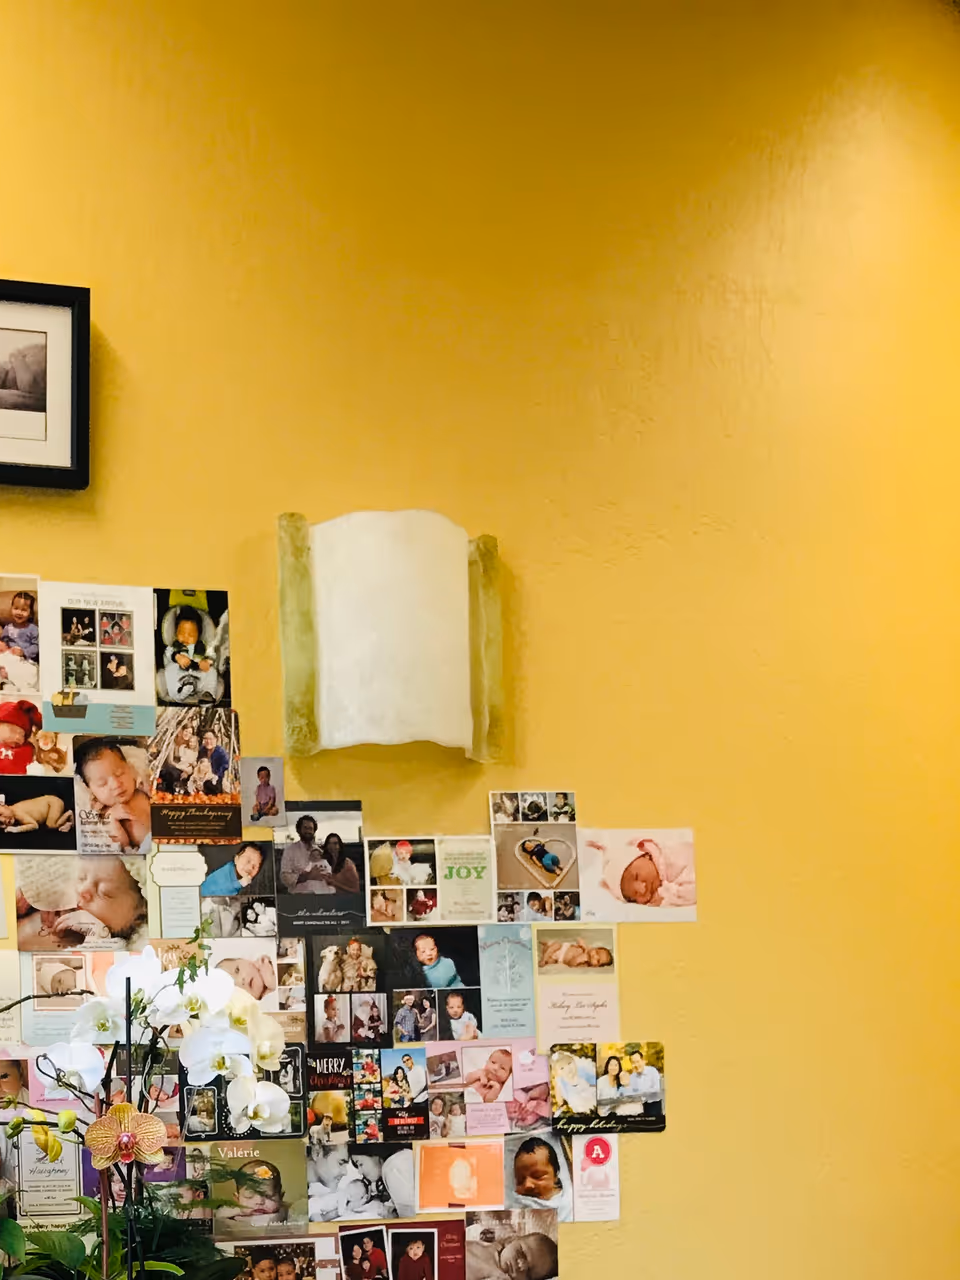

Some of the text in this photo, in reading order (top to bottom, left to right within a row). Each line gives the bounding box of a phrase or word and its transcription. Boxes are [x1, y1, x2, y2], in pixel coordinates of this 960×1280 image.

[160, 807, 233, 821] Happy Thanksgiving
[443, 865, 487, 880] JOY
[316, 1057, 345, 1074] MERRY
[556, 1118, 627, 1133] happy holidays
[217, 1147, 260, 1158] Valérie
[591, 1145, 605, 1158] A
